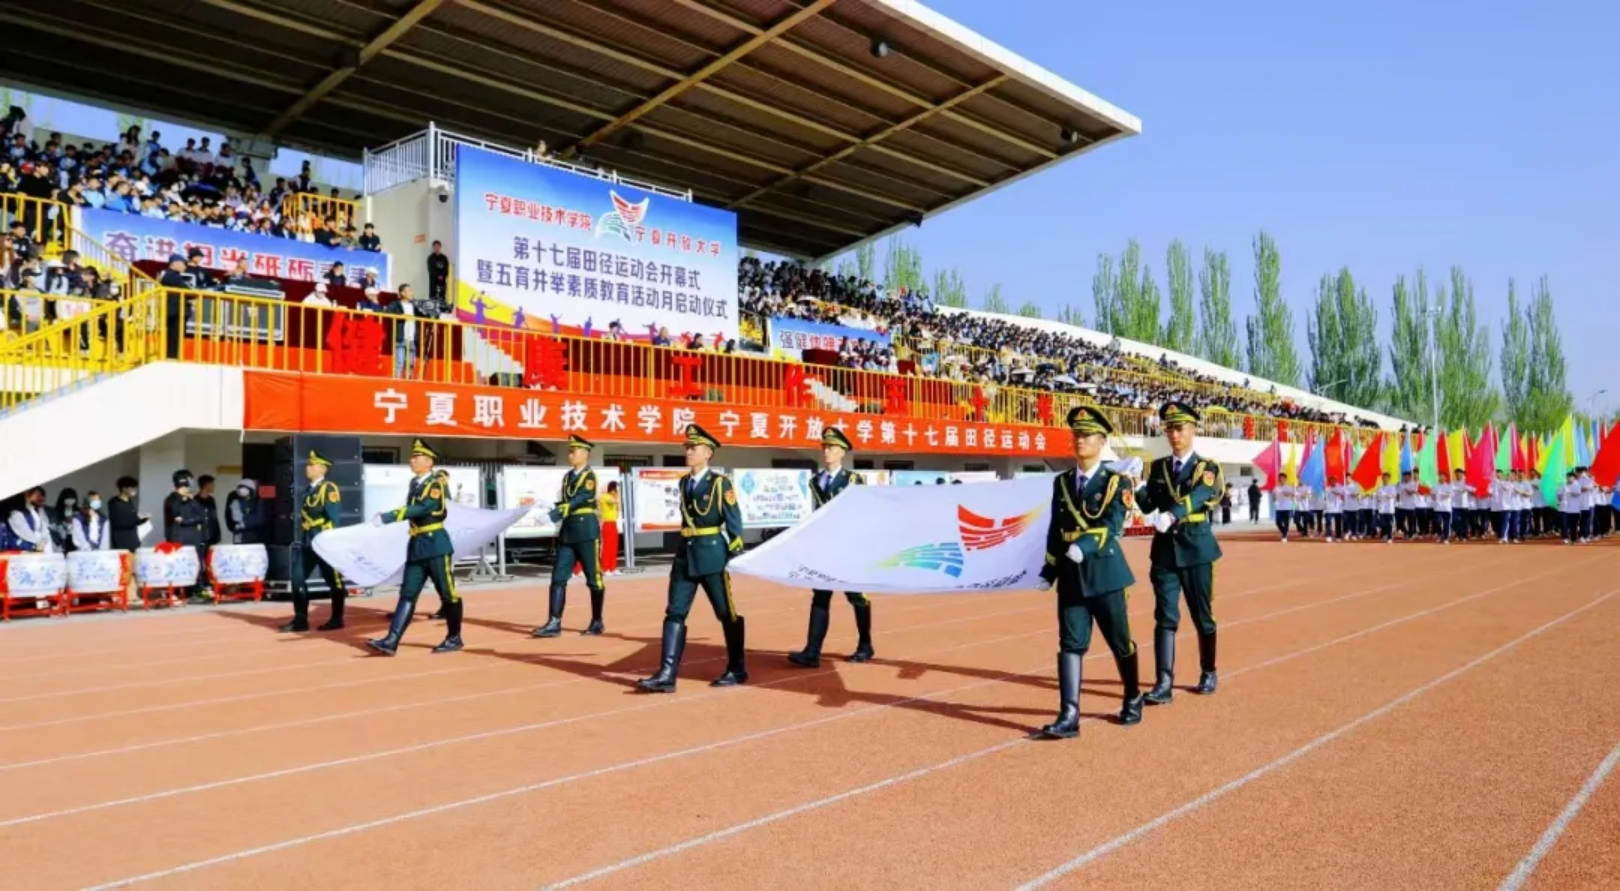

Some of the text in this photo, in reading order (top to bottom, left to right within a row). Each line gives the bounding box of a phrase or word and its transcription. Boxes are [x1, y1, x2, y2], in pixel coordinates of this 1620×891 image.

[485, 193, 721, 256] 宁夏职业技术学院 宁夏开放大学
[513, 235, 701, 291] 第十七届田径运动会开幕式
[374, 388, 696, 435] 宁夏职业技术学院
